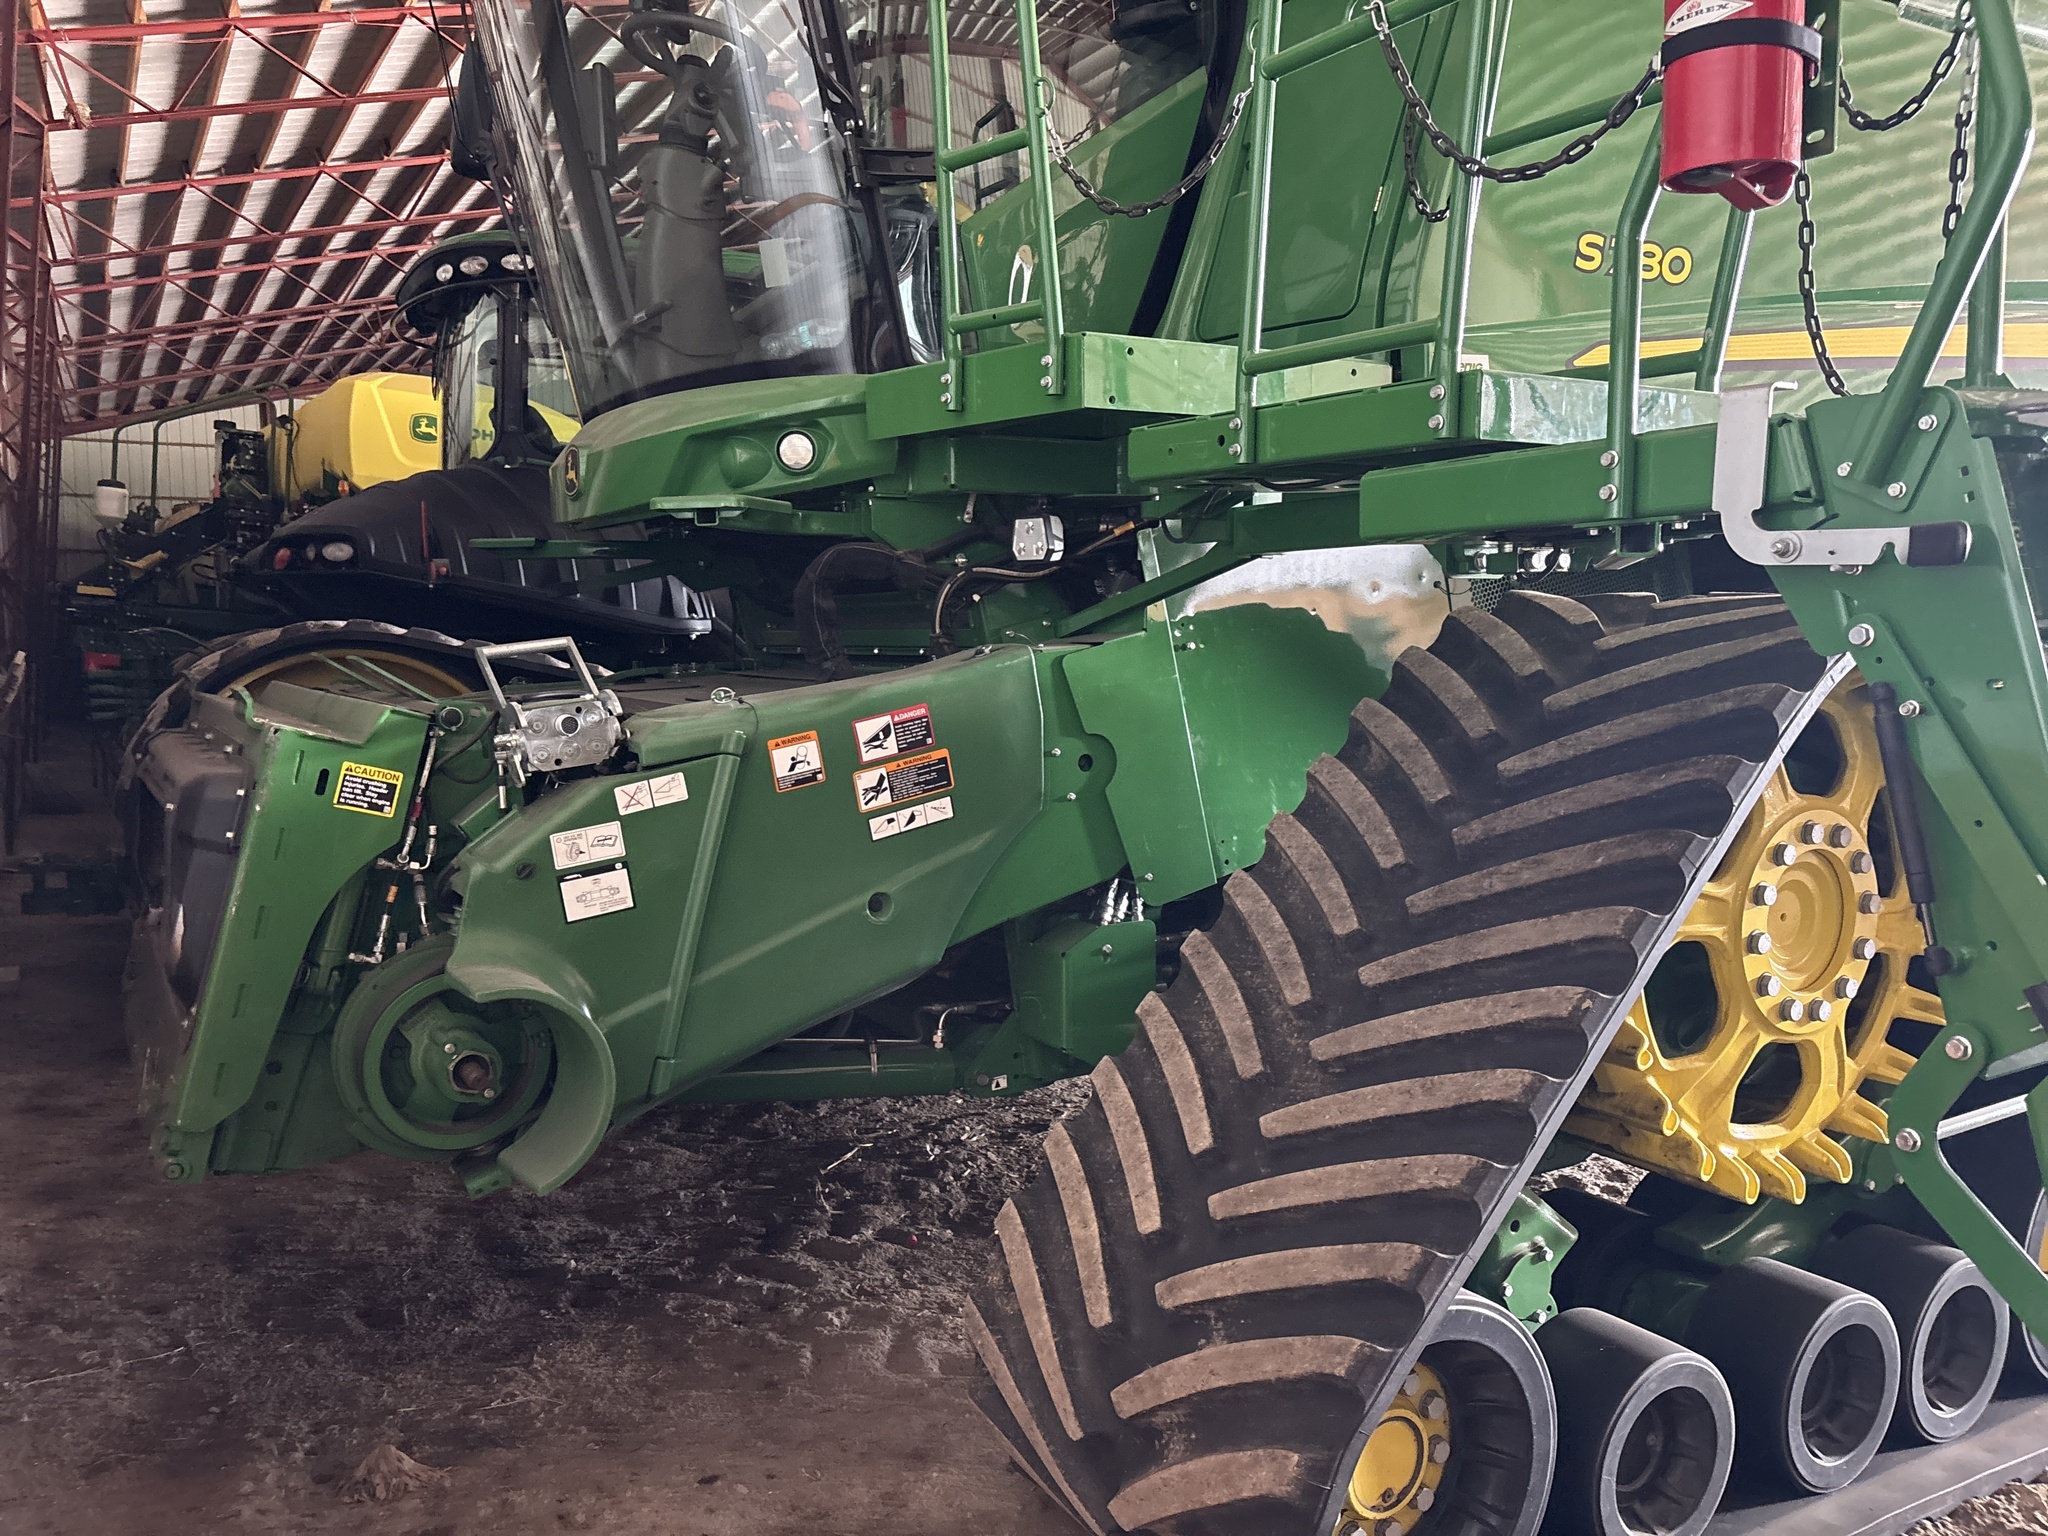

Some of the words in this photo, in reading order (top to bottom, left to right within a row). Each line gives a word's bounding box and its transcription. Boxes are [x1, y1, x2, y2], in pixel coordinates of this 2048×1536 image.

[1669, 2, 1730, 28] AMEREX
[1573, 231, 1693, 286] S80
[899, 708, 926, 720] DANGER
[781, 734, 811, 745] WARNING
[903, 754, 932, 766] WARNING
[354, 767, 399, 782] CAUTION
[345, 775, 362, 783] Avoid
[362, 779, 387, 789] crushing
[368, 786, 388, 794] Header
[371, 798, 390, 806] engine
